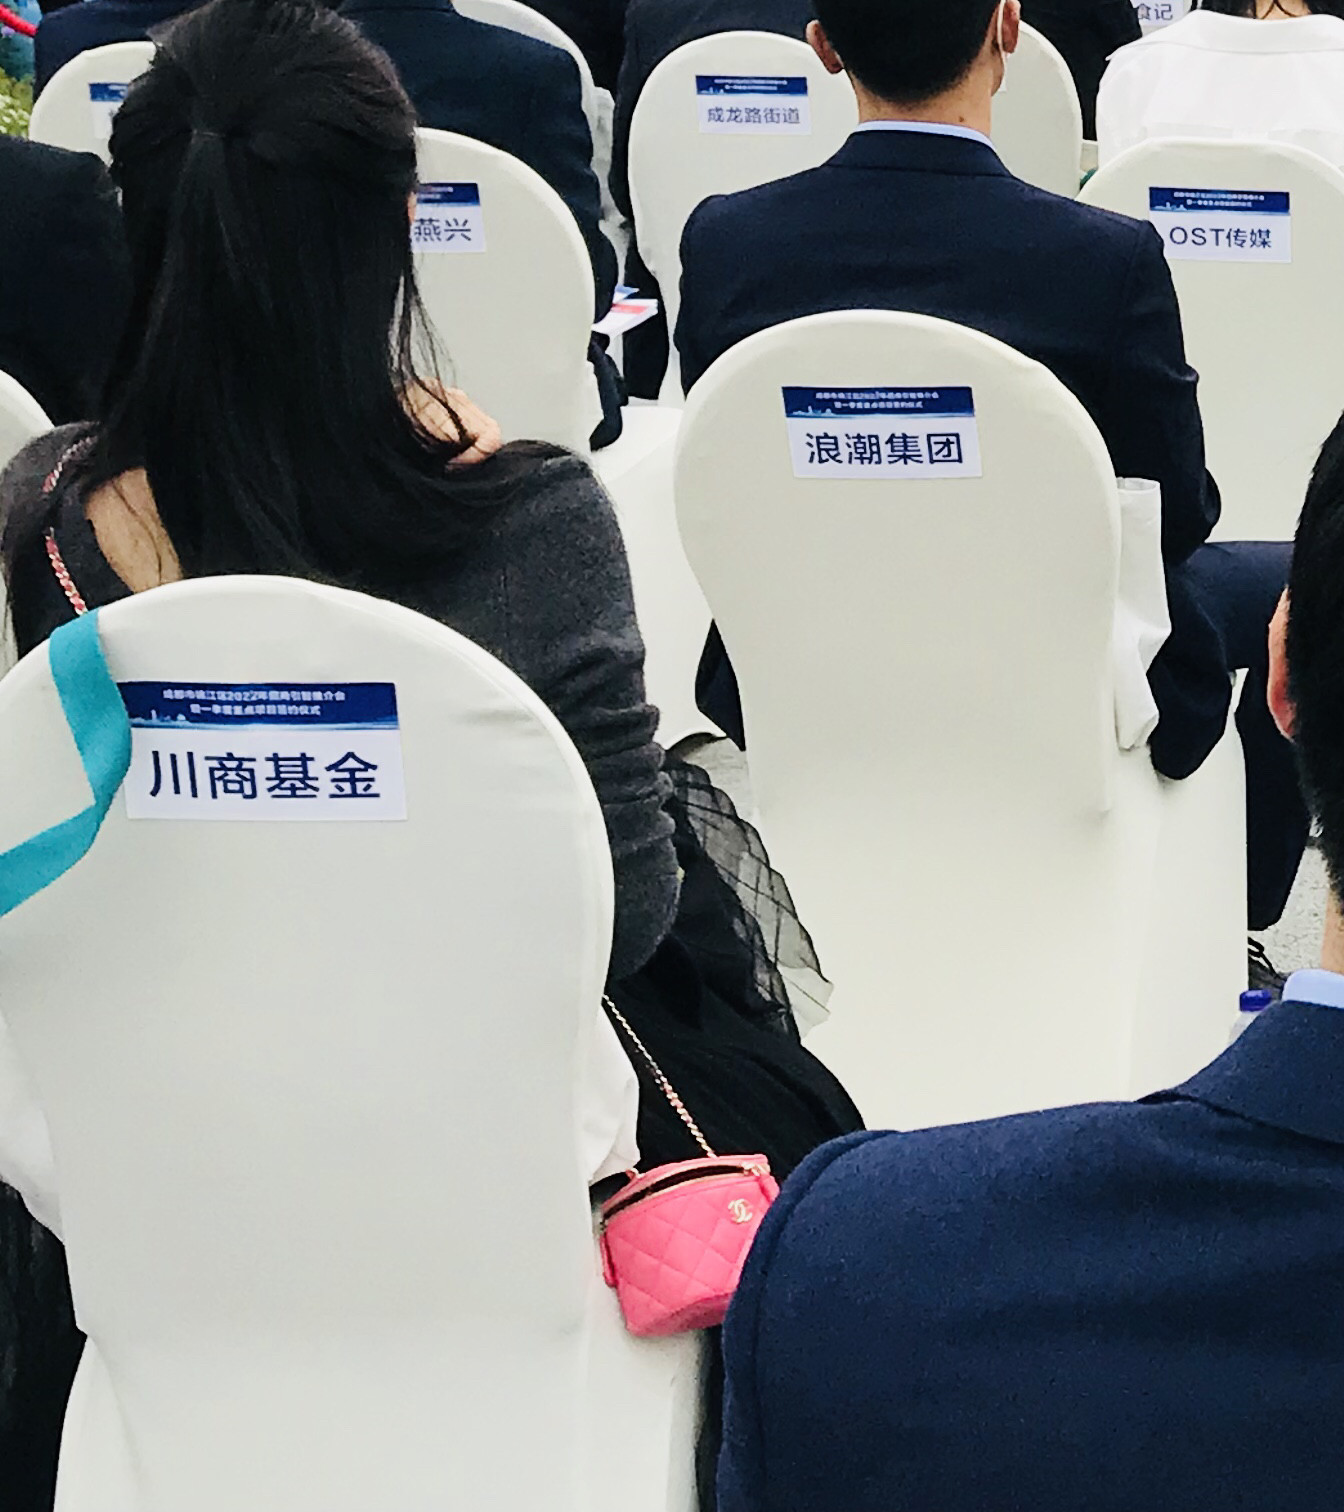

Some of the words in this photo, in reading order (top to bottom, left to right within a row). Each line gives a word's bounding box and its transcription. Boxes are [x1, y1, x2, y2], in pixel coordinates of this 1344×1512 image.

[707, 106, 801, 125] 成龙路街道
[1169, 226, 1272, 249] OST传媒
[806, 432, 964, 466] 浪潮集团
[149, 750, 381, 800] 川商基金
